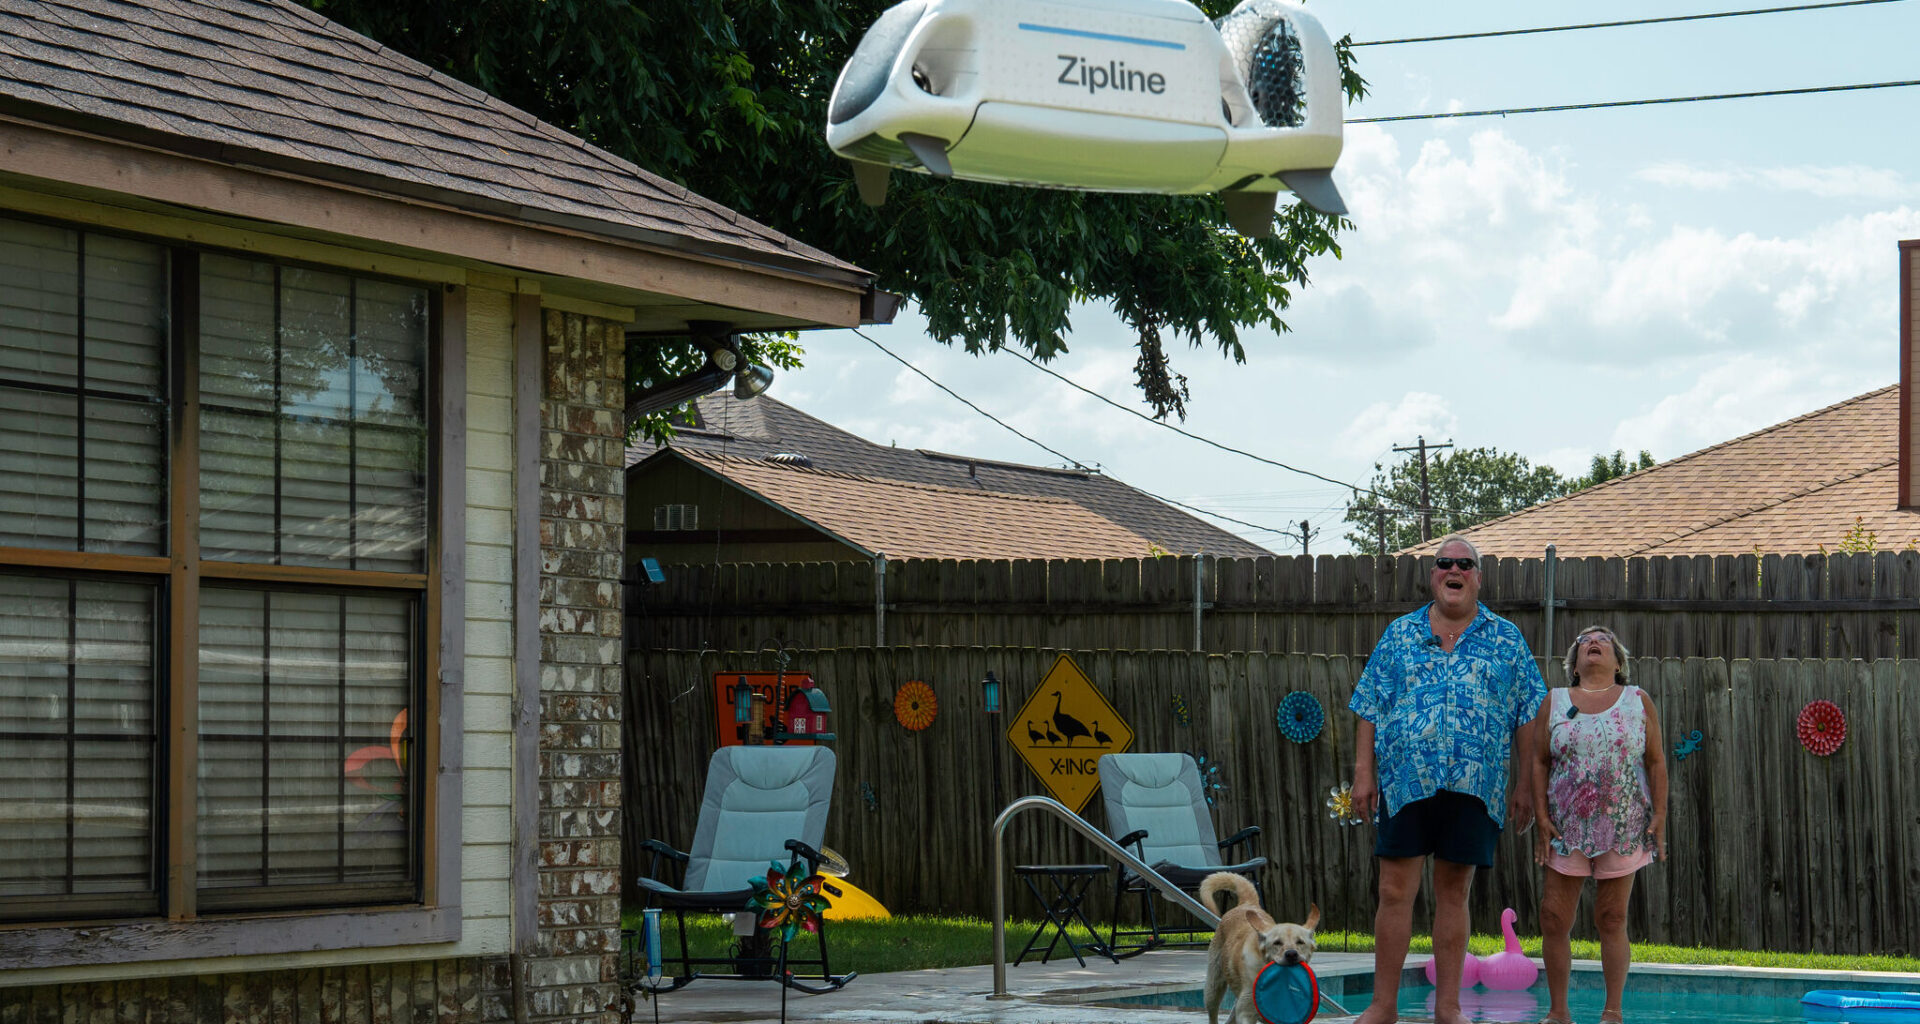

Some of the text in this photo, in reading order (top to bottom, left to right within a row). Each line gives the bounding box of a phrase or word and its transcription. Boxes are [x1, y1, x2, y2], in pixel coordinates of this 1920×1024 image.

[1057, 54, 1166, 94] Zipline
[726, 685, 800, 705] DTOU
[1050, 758, 1097, 776] X-ING
